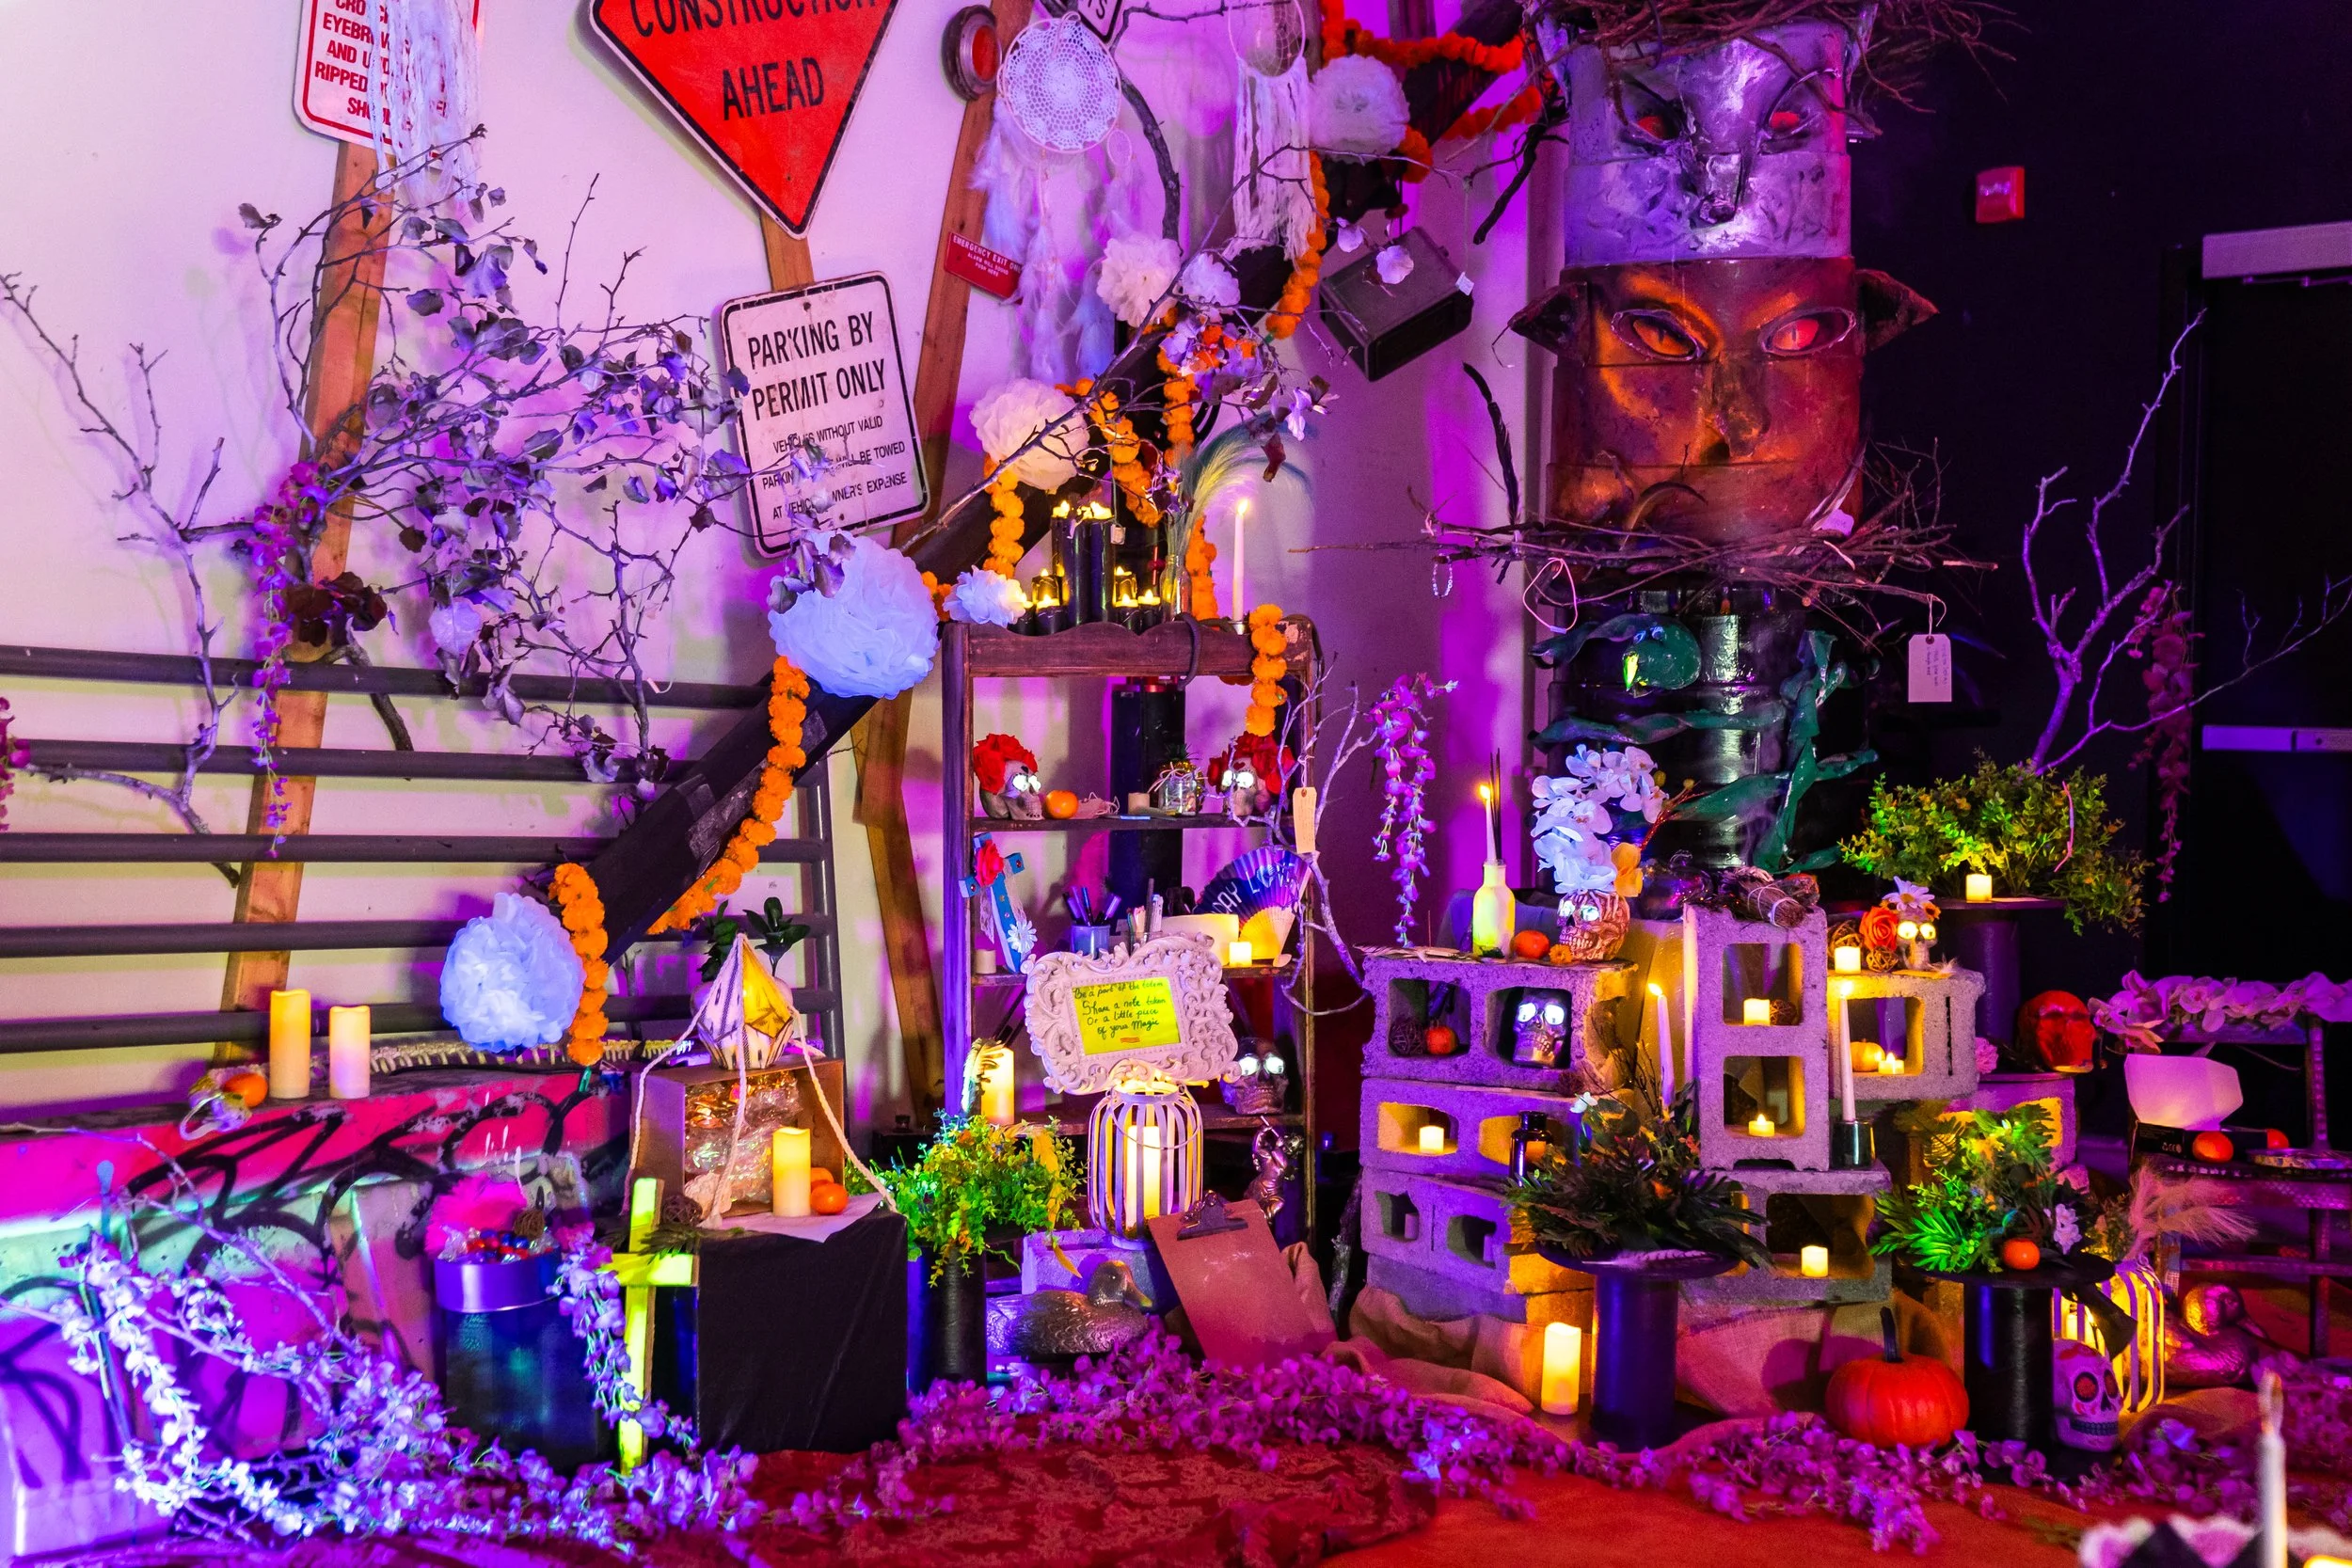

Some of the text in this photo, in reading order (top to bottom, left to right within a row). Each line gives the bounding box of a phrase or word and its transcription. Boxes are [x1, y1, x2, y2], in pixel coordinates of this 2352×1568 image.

[327, 40, 357, 64] AND
[314, 61, 368, 92] RIPPED
[723, 57, 824, 120] AHEAD
[952, 235, 991, 258] EMERGENCY
[993, 254, 1008, 266] EXIT
[748, 311, 874, 370] PARKING BY
[752, 358, 885, 420] PERMIT ONLY
[817, 421, 855, 442] WITHOUT
[857, 415, 882, 431] VALID
[762, 469, 797, 489] PARKIN
[859, 450, 872, 464] BE
[873, 441, 905, 459] TOWED
[773, 506, 783, 519] AT
[866, 472, 907, 493] EXPENSE
[1097, 986, 1113, 997] part
[1124, 996, 1140, 1006] note
[1114, 1009, 1133, 1021] little
